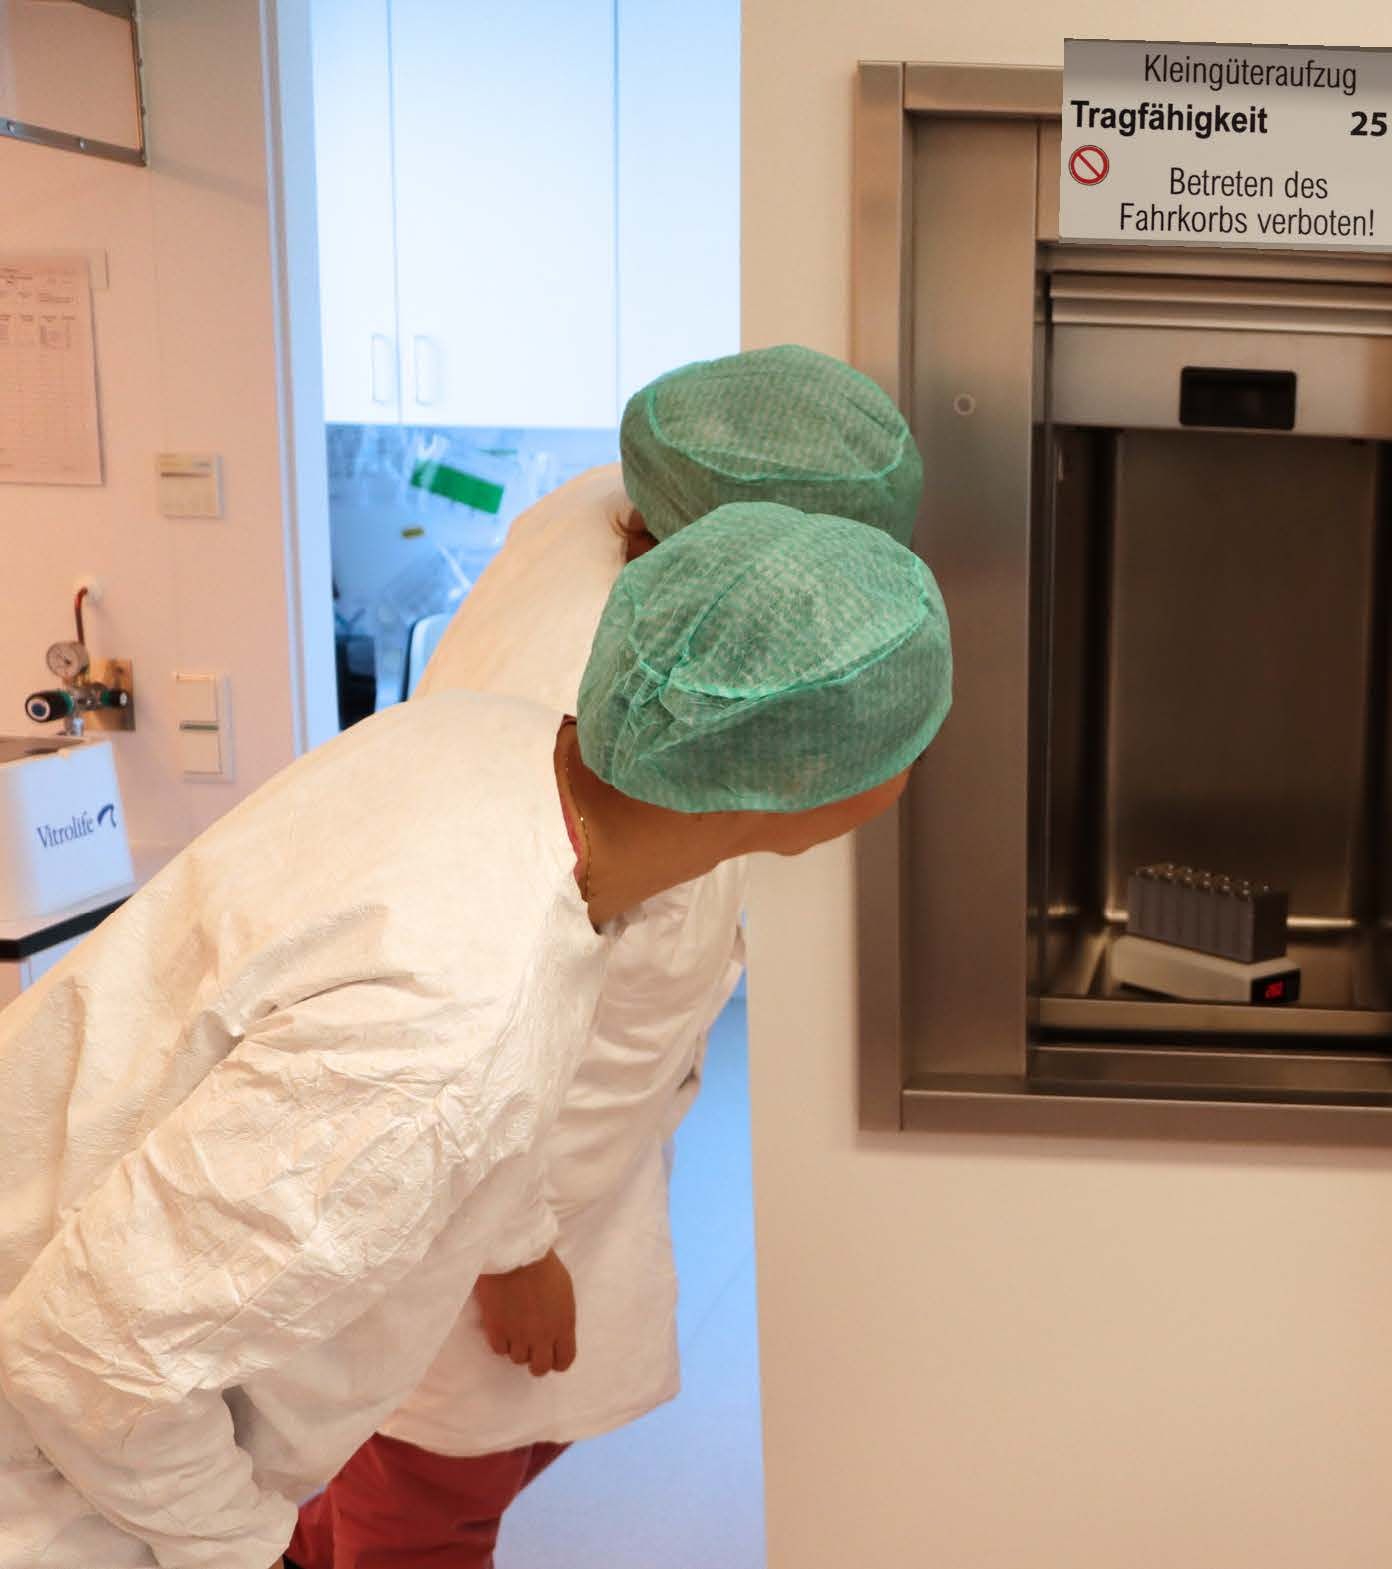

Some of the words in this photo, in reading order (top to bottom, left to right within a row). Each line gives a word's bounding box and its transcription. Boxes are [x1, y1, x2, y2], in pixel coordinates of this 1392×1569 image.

[1144, 54, 1357, 96] Kleingüteraufzug
[1070, 100, 1268, 139] Tragfähigkeit
[1350, 111, 1388, 137] 25
[1170, 167, 1273, 198] Betreten
[1284, 171, 1328, 199] des
[1119, 202, 1248, 234] Fahrkorbs
[1257, 207, 1374, 237] verboten!
[36, 810, 94, 848] Vitrolife
